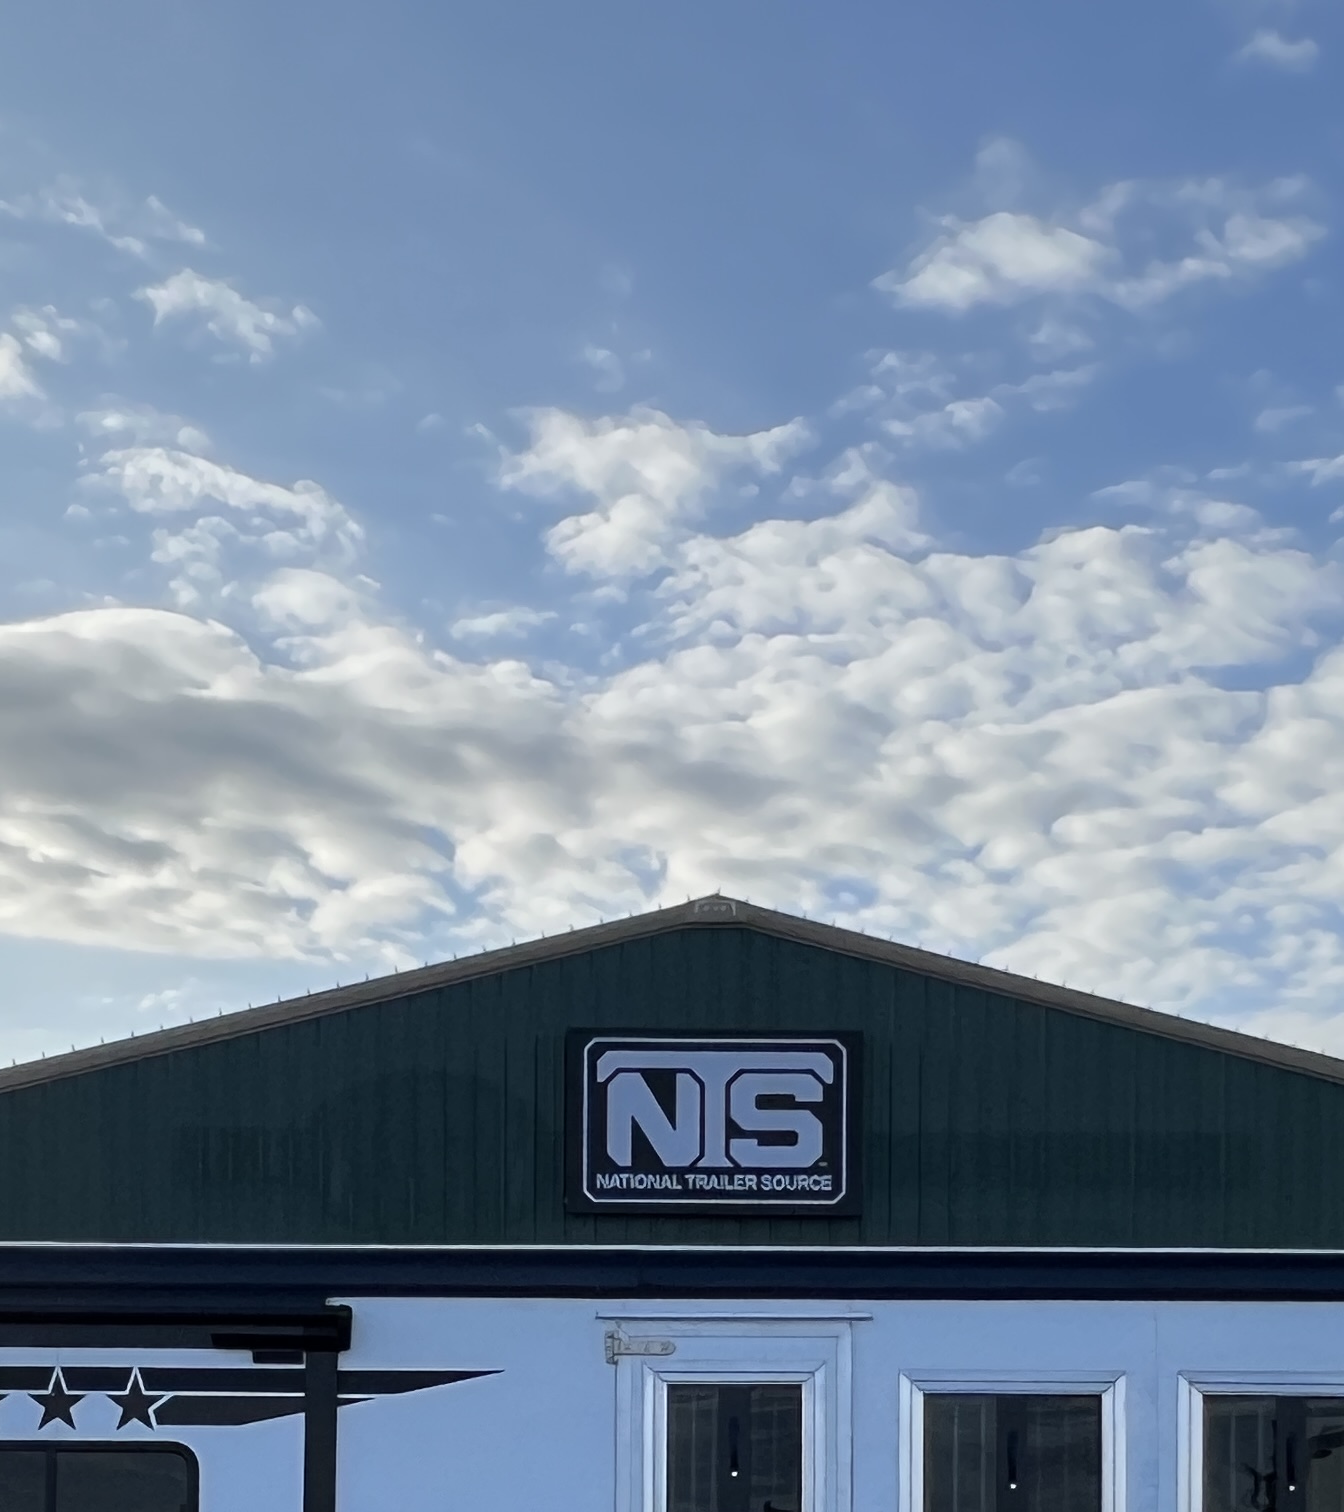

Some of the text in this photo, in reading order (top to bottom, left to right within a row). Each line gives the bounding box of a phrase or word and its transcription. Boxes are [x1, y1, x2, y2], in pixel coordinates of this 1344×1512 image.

[596, 1050, 834, 1168] NTS
[596, 1173, 833, 1192] NATIONAL TRAILER SOURCE
